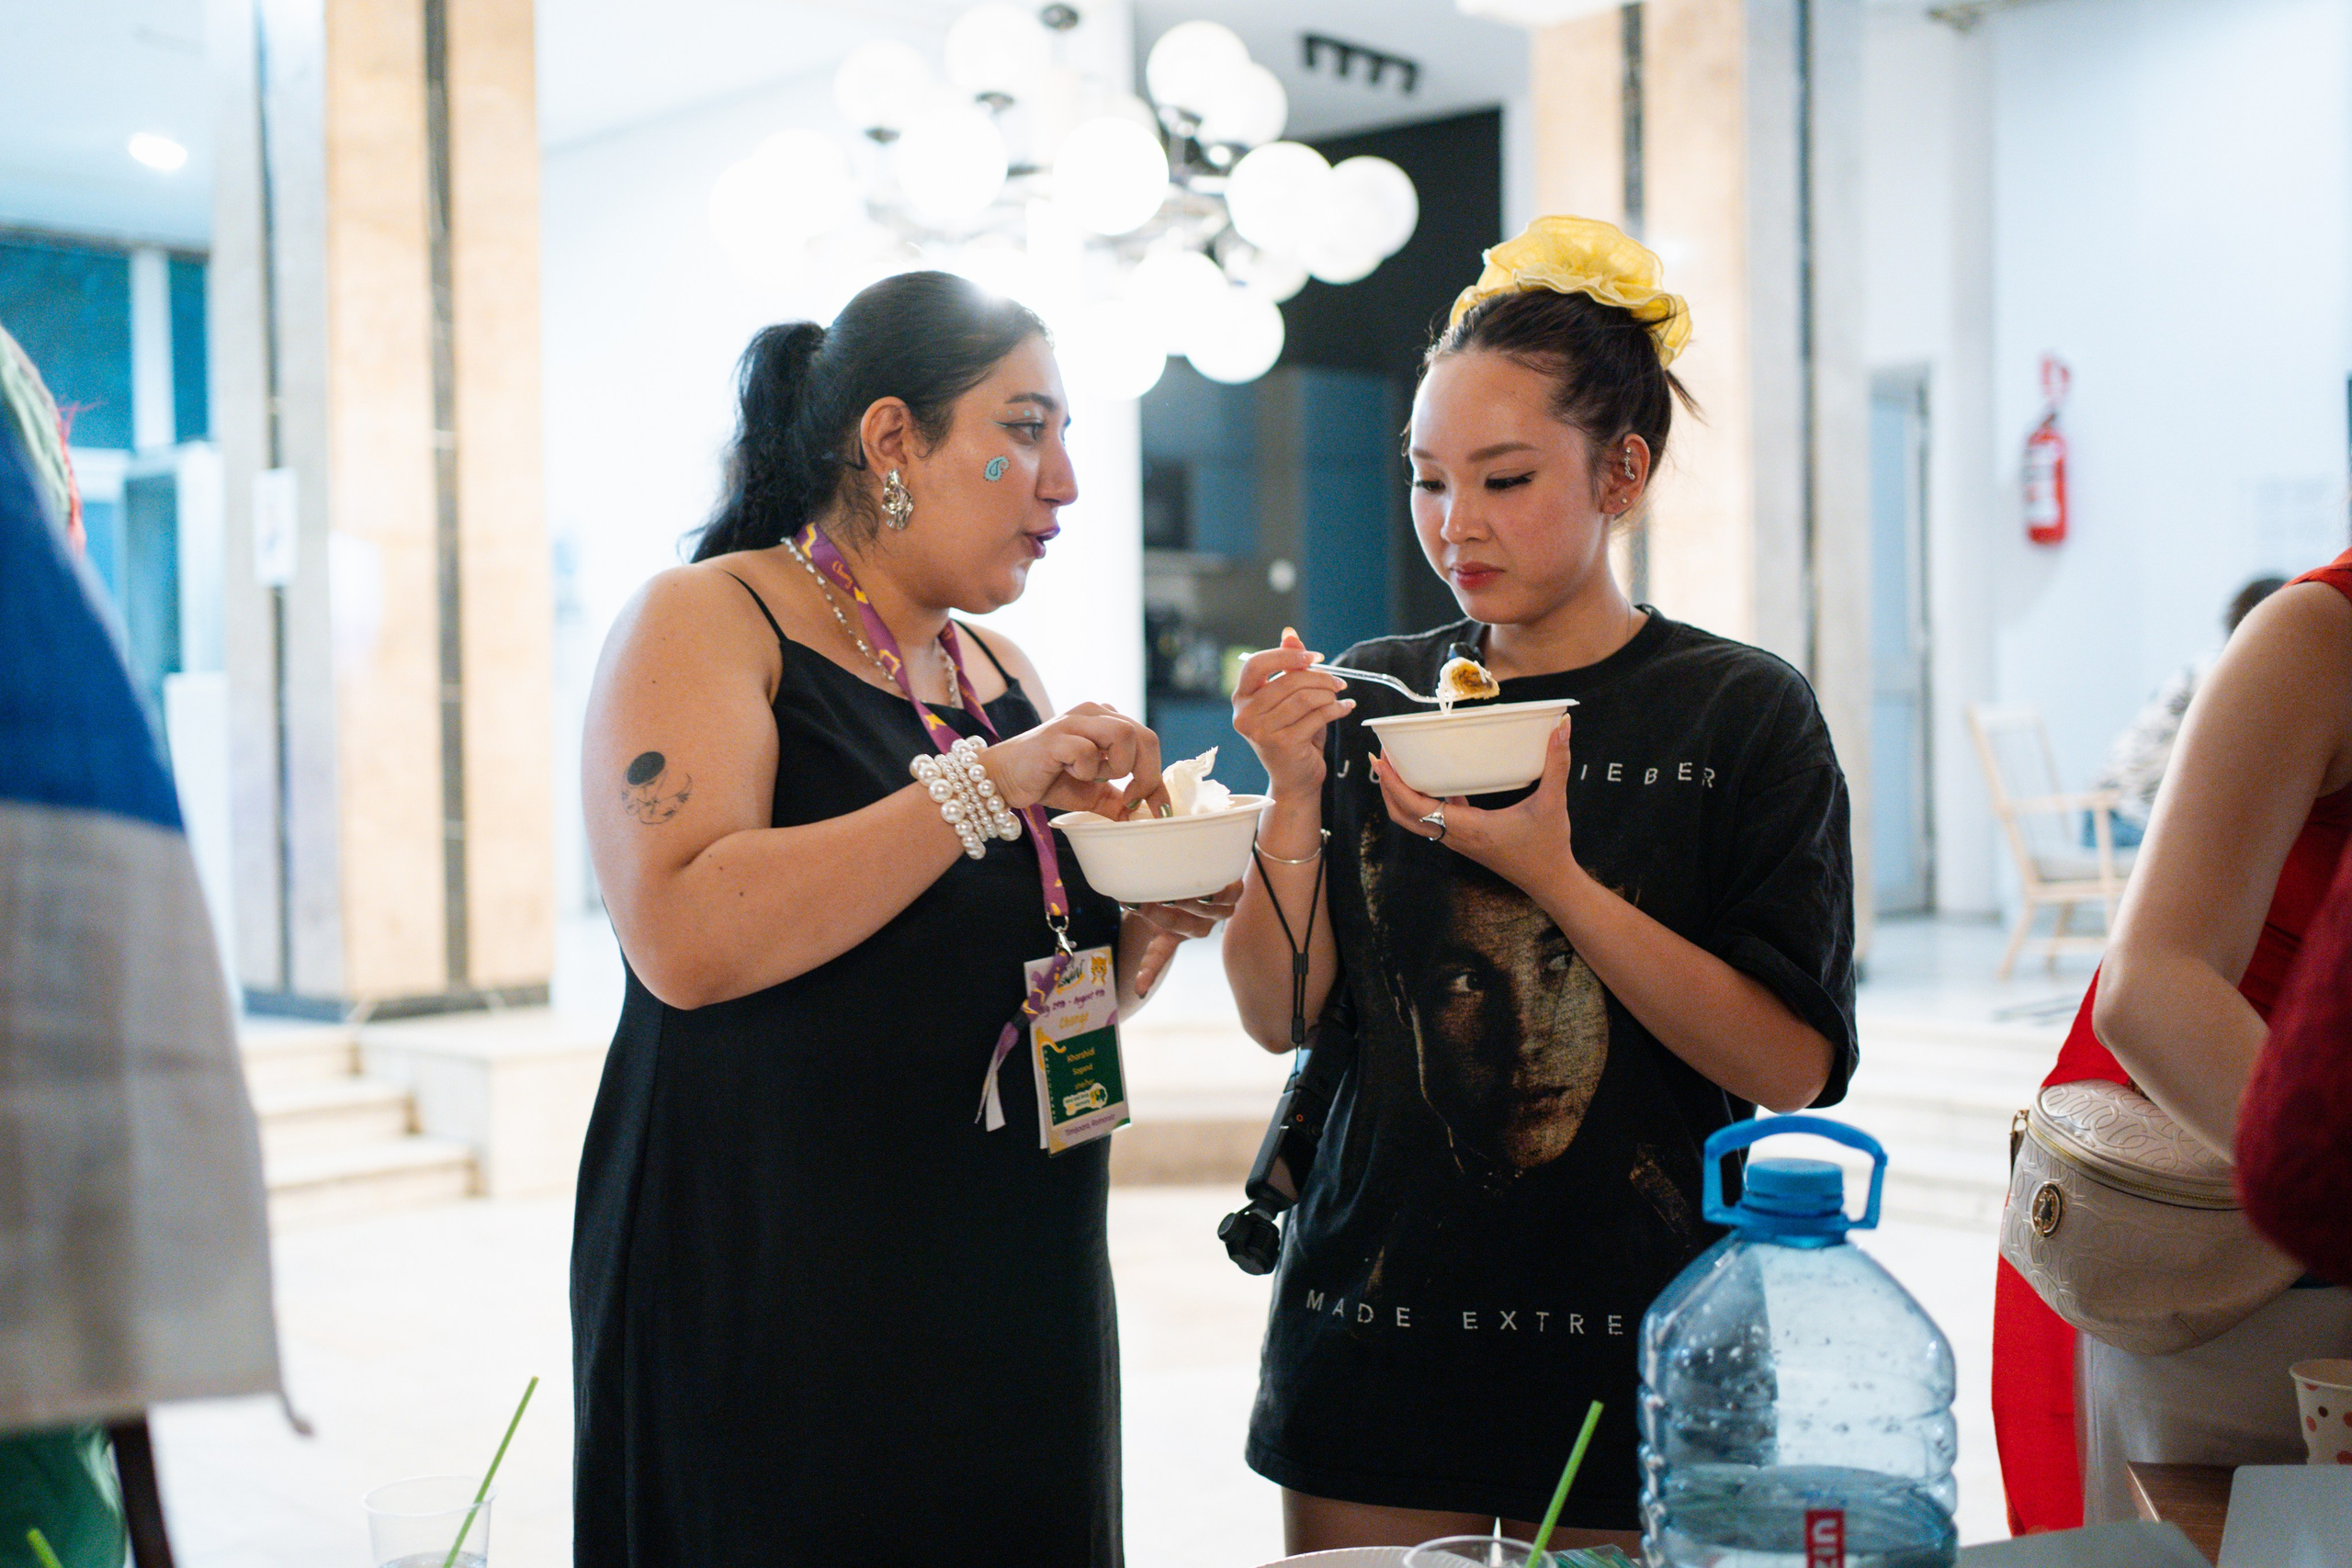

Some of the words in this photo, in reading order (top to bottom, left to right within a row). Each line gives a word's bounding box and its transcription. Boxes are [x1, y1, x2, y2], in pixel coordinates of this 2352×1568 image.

[1581, 762, 1715, 789] IEBER
[1305, 1289, 1411, 1328] MADE
[1462, 1311, 1623, 1336] EXTRE
